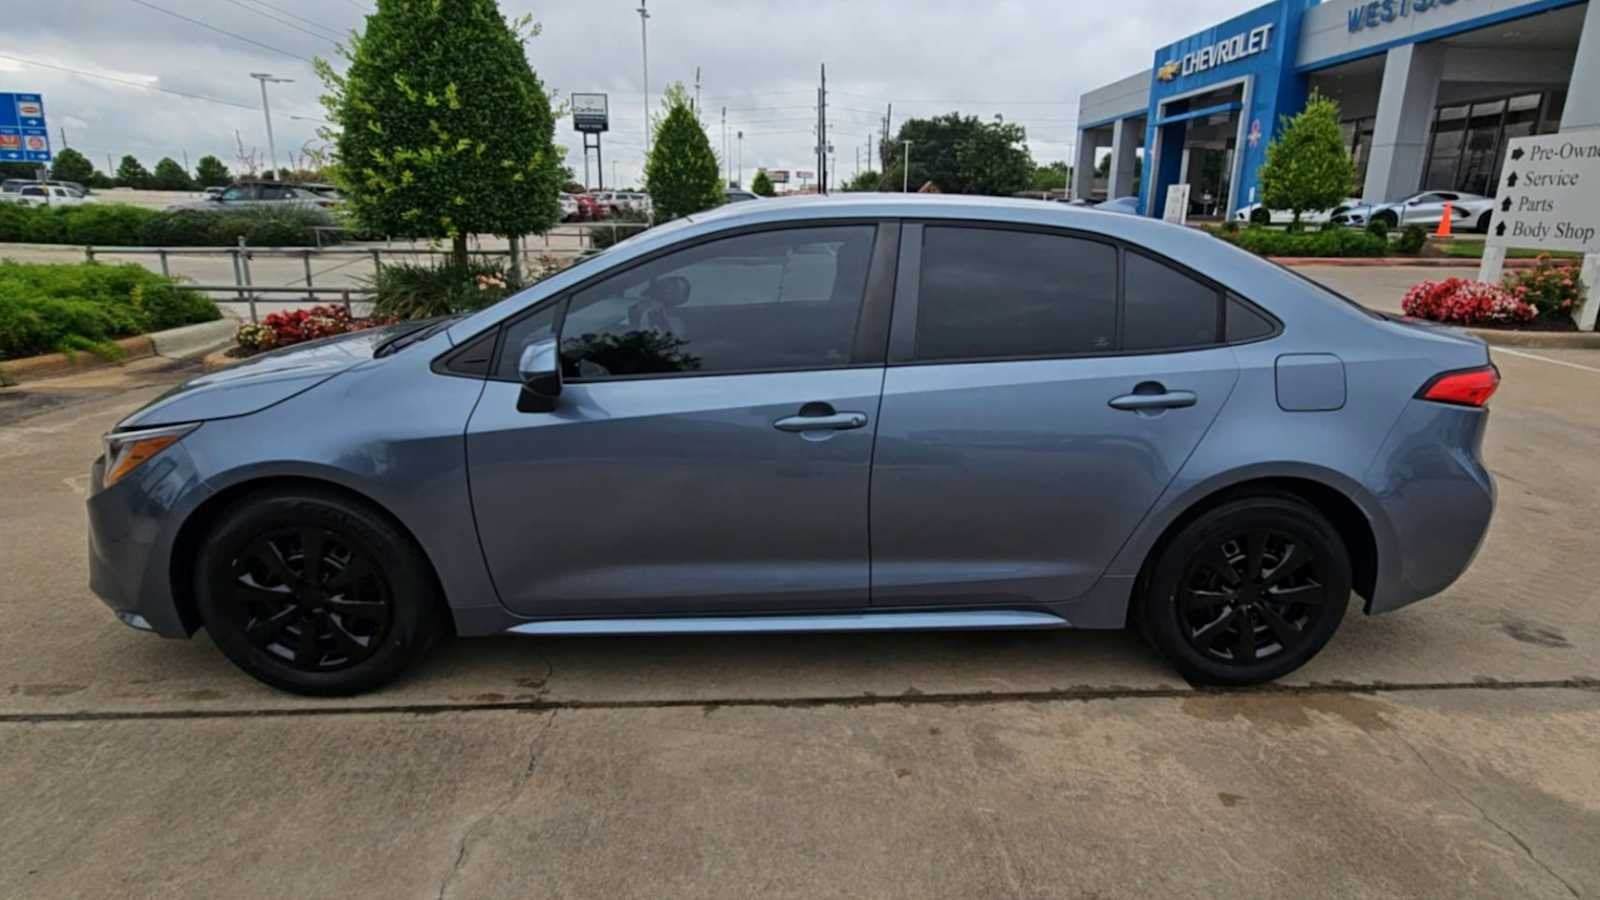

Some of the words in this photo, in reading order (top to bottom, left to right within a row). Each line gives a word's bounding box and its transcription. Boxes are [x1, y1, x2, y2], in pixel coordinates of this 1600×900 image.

[1348, 0, 1457, 33] WEST
[1182, 22, 1274, 77] CHEVROLET
[1523, 168, 1579, 187] Service
[1518, 195, 1554, 212] Parts
[1512, 220, 1551, 242] Body
[1554, 221, 1595, 244] Shop
